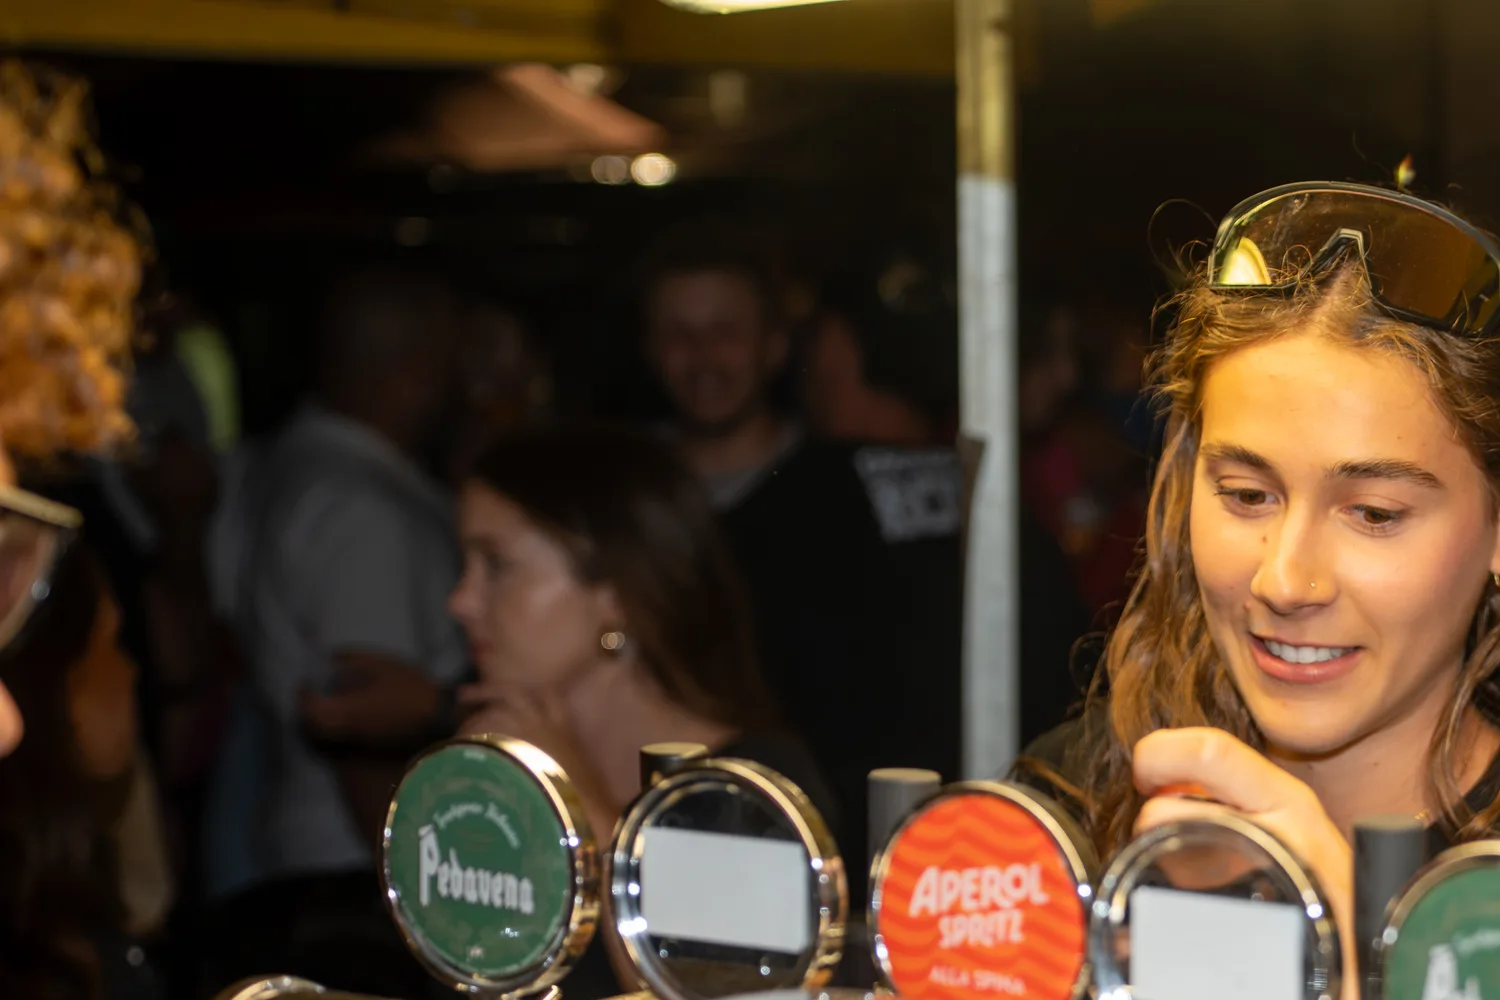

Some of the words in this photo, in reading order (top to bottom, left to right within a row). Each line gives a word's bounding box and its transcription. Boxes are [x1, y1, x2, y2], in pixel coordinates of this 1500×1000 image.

[419, 824, 535, 915] Pedavena
[909, 862, 1049, 918] APEROL
[940, 909, 1023, 948] SPRITZ
[930, 965, 969, 986] ALLA
